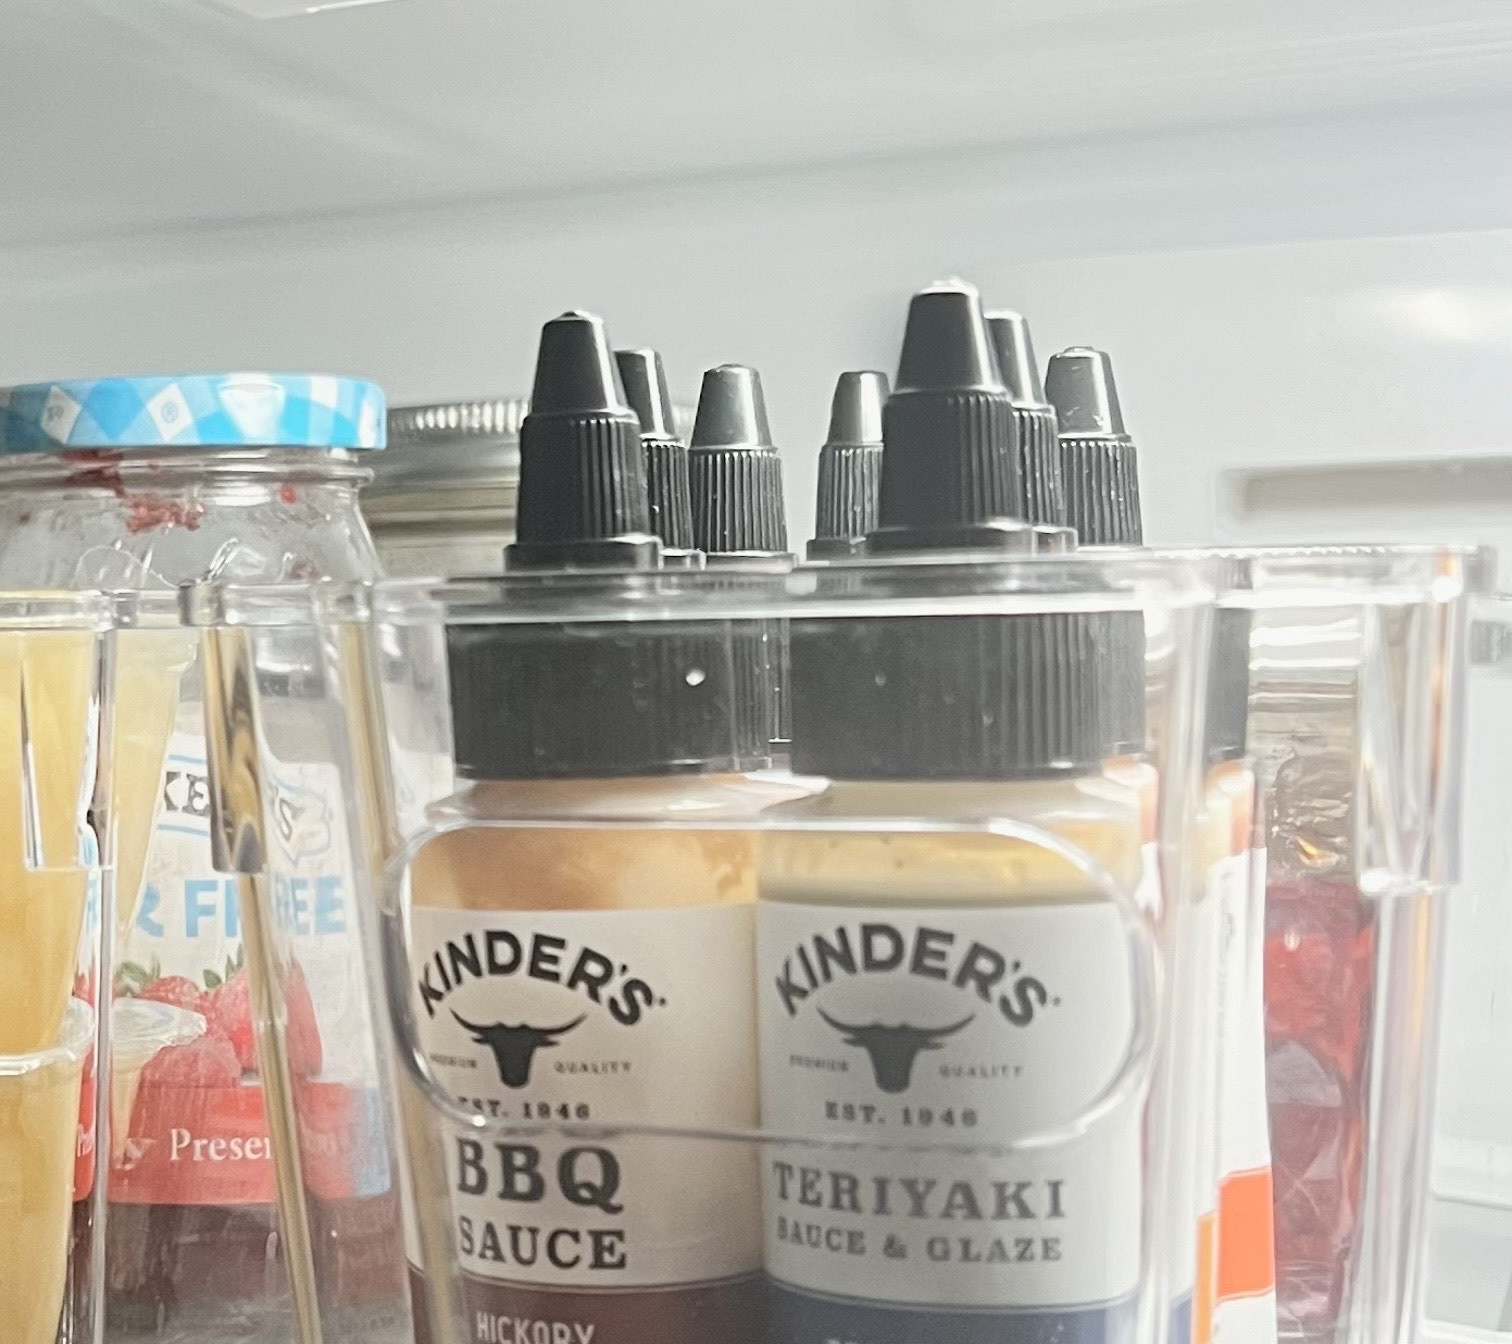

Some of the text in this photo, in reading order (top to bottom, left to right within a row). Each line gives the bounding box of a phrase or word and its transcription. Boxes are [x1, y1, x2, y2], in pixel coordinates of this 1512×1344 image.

[418, 929, 654, 1026] KINDER'S
[775, 921, 1050, 1027] KINDER'S
[825, 1101, 886, 1125] EST.
[456, 1137, 624, 1215] BBQ
[773, 1160, 1065, 1221] TERIYAKI
[458, 1216, 627, 1270] SAUCE
[777, 1215, 1063, 1263] SAUCE & GLAZE
